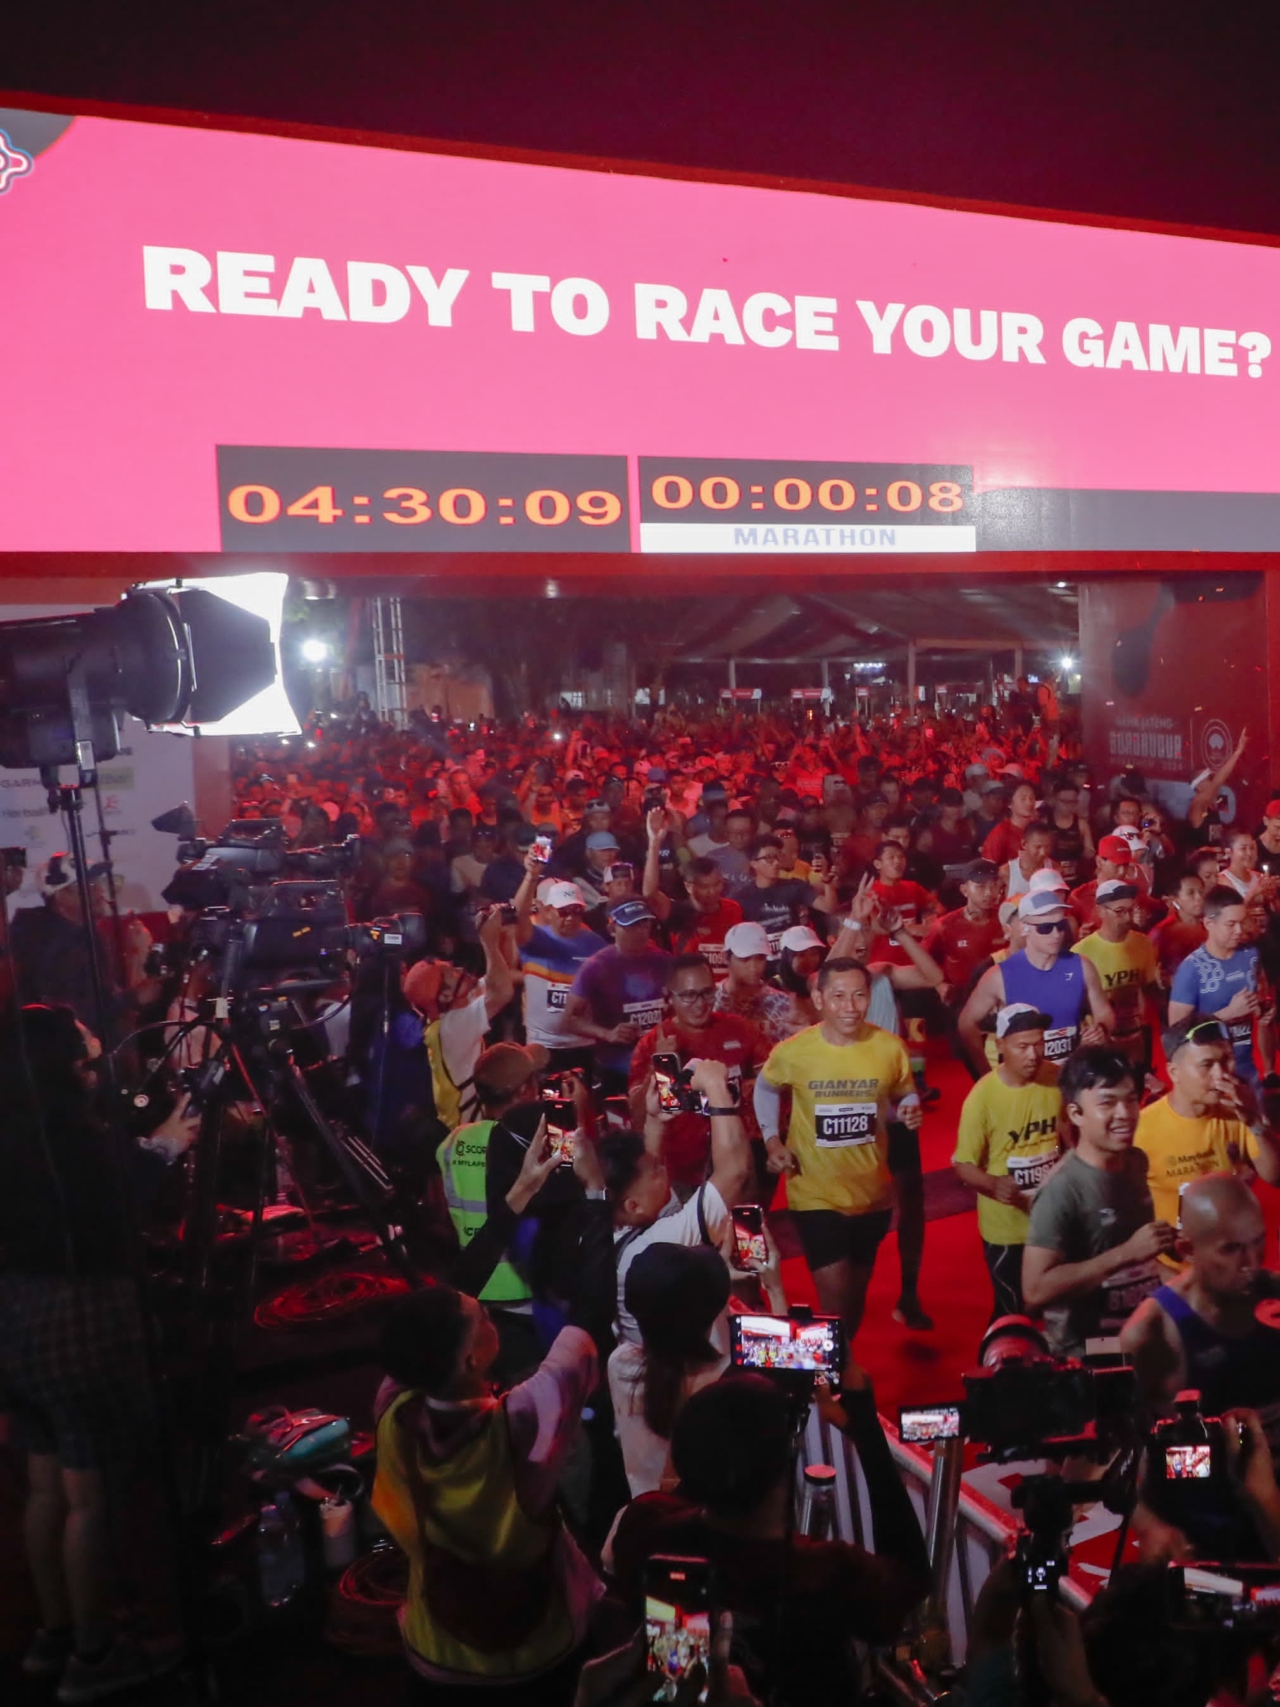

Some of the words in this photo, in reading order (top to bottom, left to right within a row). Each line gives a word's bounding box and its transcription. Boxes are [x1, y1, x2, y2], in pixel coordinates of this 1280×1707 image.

[142, 245, 469, 327] READY
[492, 272, 609, 336] TO
[634, 282, 839, 351] RACE
[856, 300, 1046, 364] YOUR
[1062, 317, 1271, 378] GAME?
[650, 476, 965, 513] 00:00:08
[226, 484, 623, 526] 04:30:09
[733, 525, 897, 548] MARATHON
[0, 779, 41, 788] GARM
[1104, 969, 1139, 987] YPH
[551, 992, 567, 1005] C11
[1044, 1037, 1072, 1056] 12031
[808, 1079, 879, 1090] GIANYAR
[823, 1115, 868, 1135] C11128
[1008, 1116, 1056, 1143] YPH
